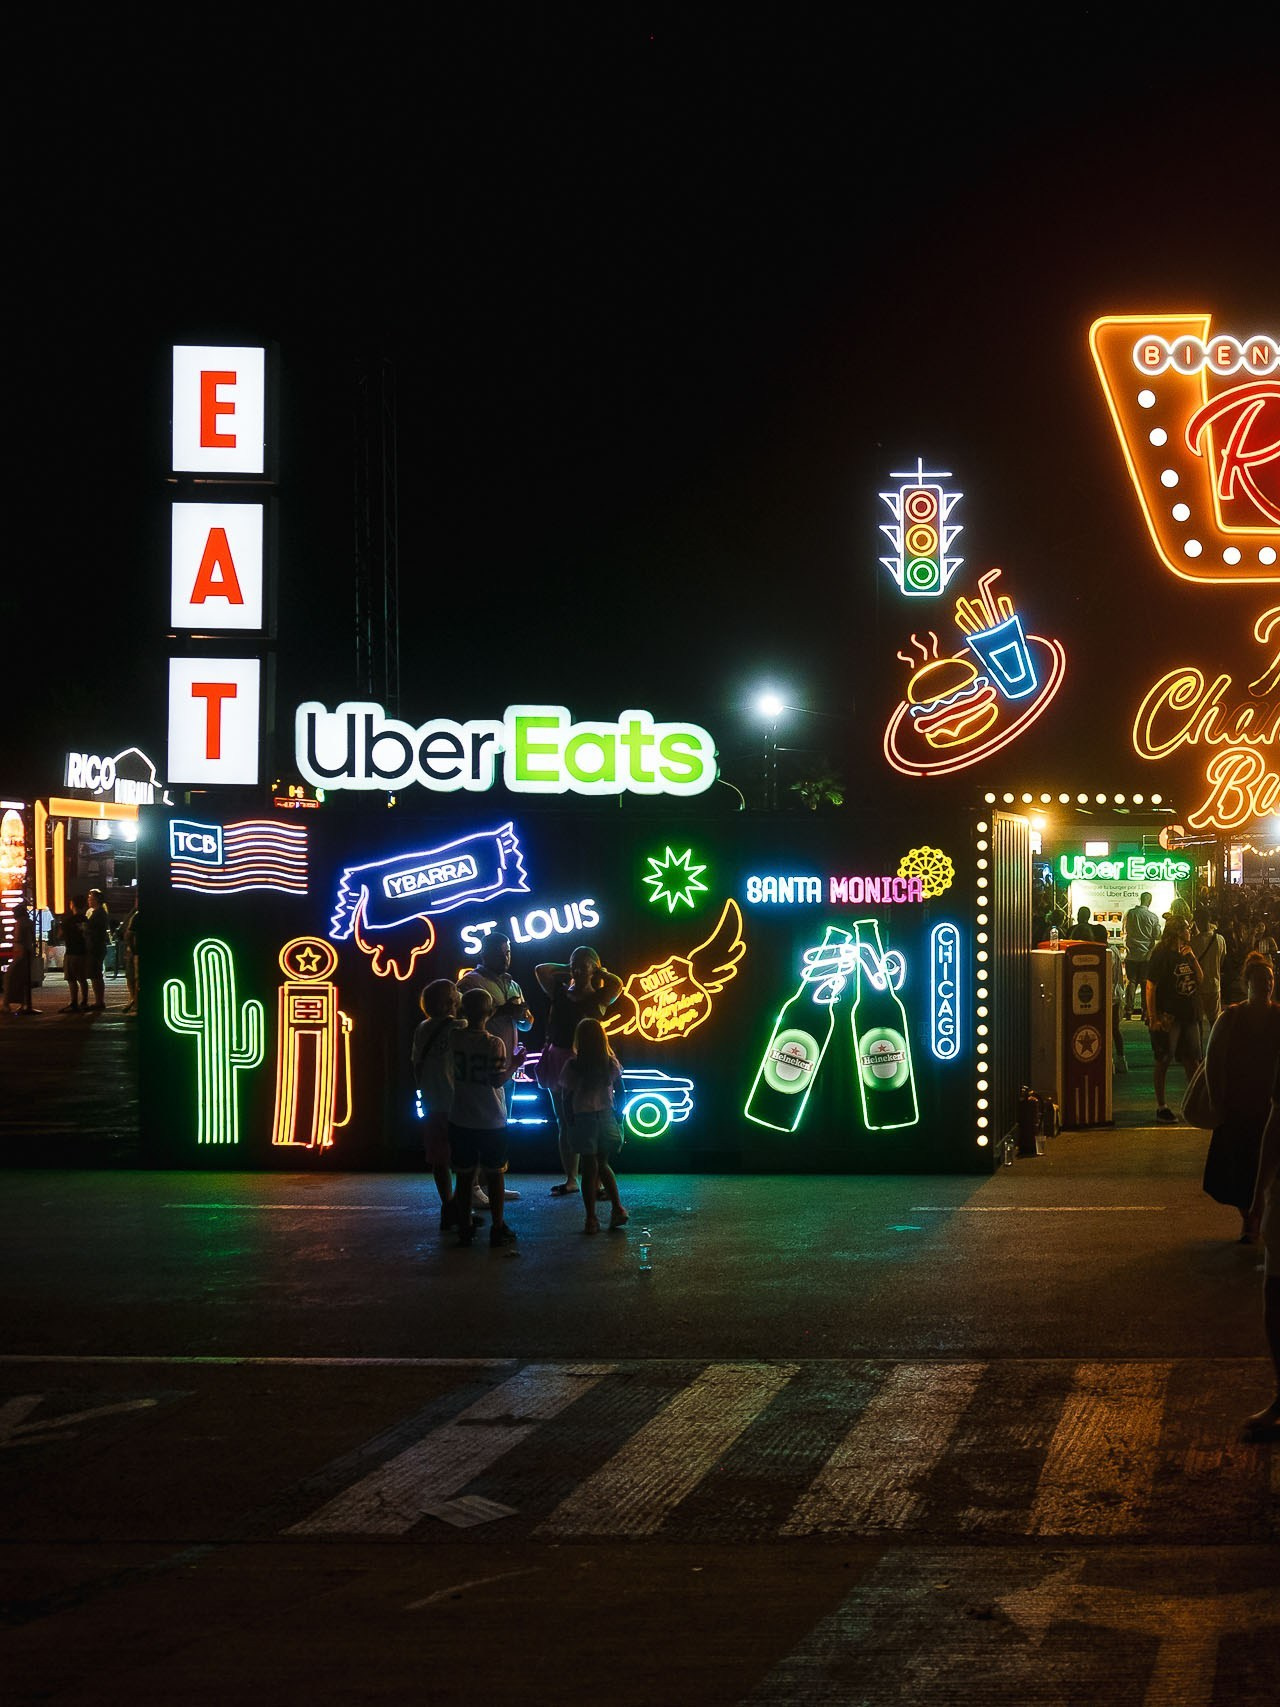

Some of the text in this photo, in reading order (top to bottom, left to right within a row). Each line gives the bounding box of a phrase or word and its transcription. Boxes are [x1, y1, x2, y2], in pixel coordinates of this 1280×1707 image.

[306, 712, 704, 783] Uber Eats
[174, 831, 218, 854] TCB
[388, 861, 474, 895] YBARRA
[1060, 855, 1191, 881] Uber Eats
[746, 876, 923, 903] SANTA MONICA
[509, 898, 600, 944] LOUIS
[640, 964, 679, 993] ROUTE
[937, 928, 956, 1057] CHICAGO
[771, 1049, 812, 1071] Heineken
[862, 1052, 905, 1065] Heineken
